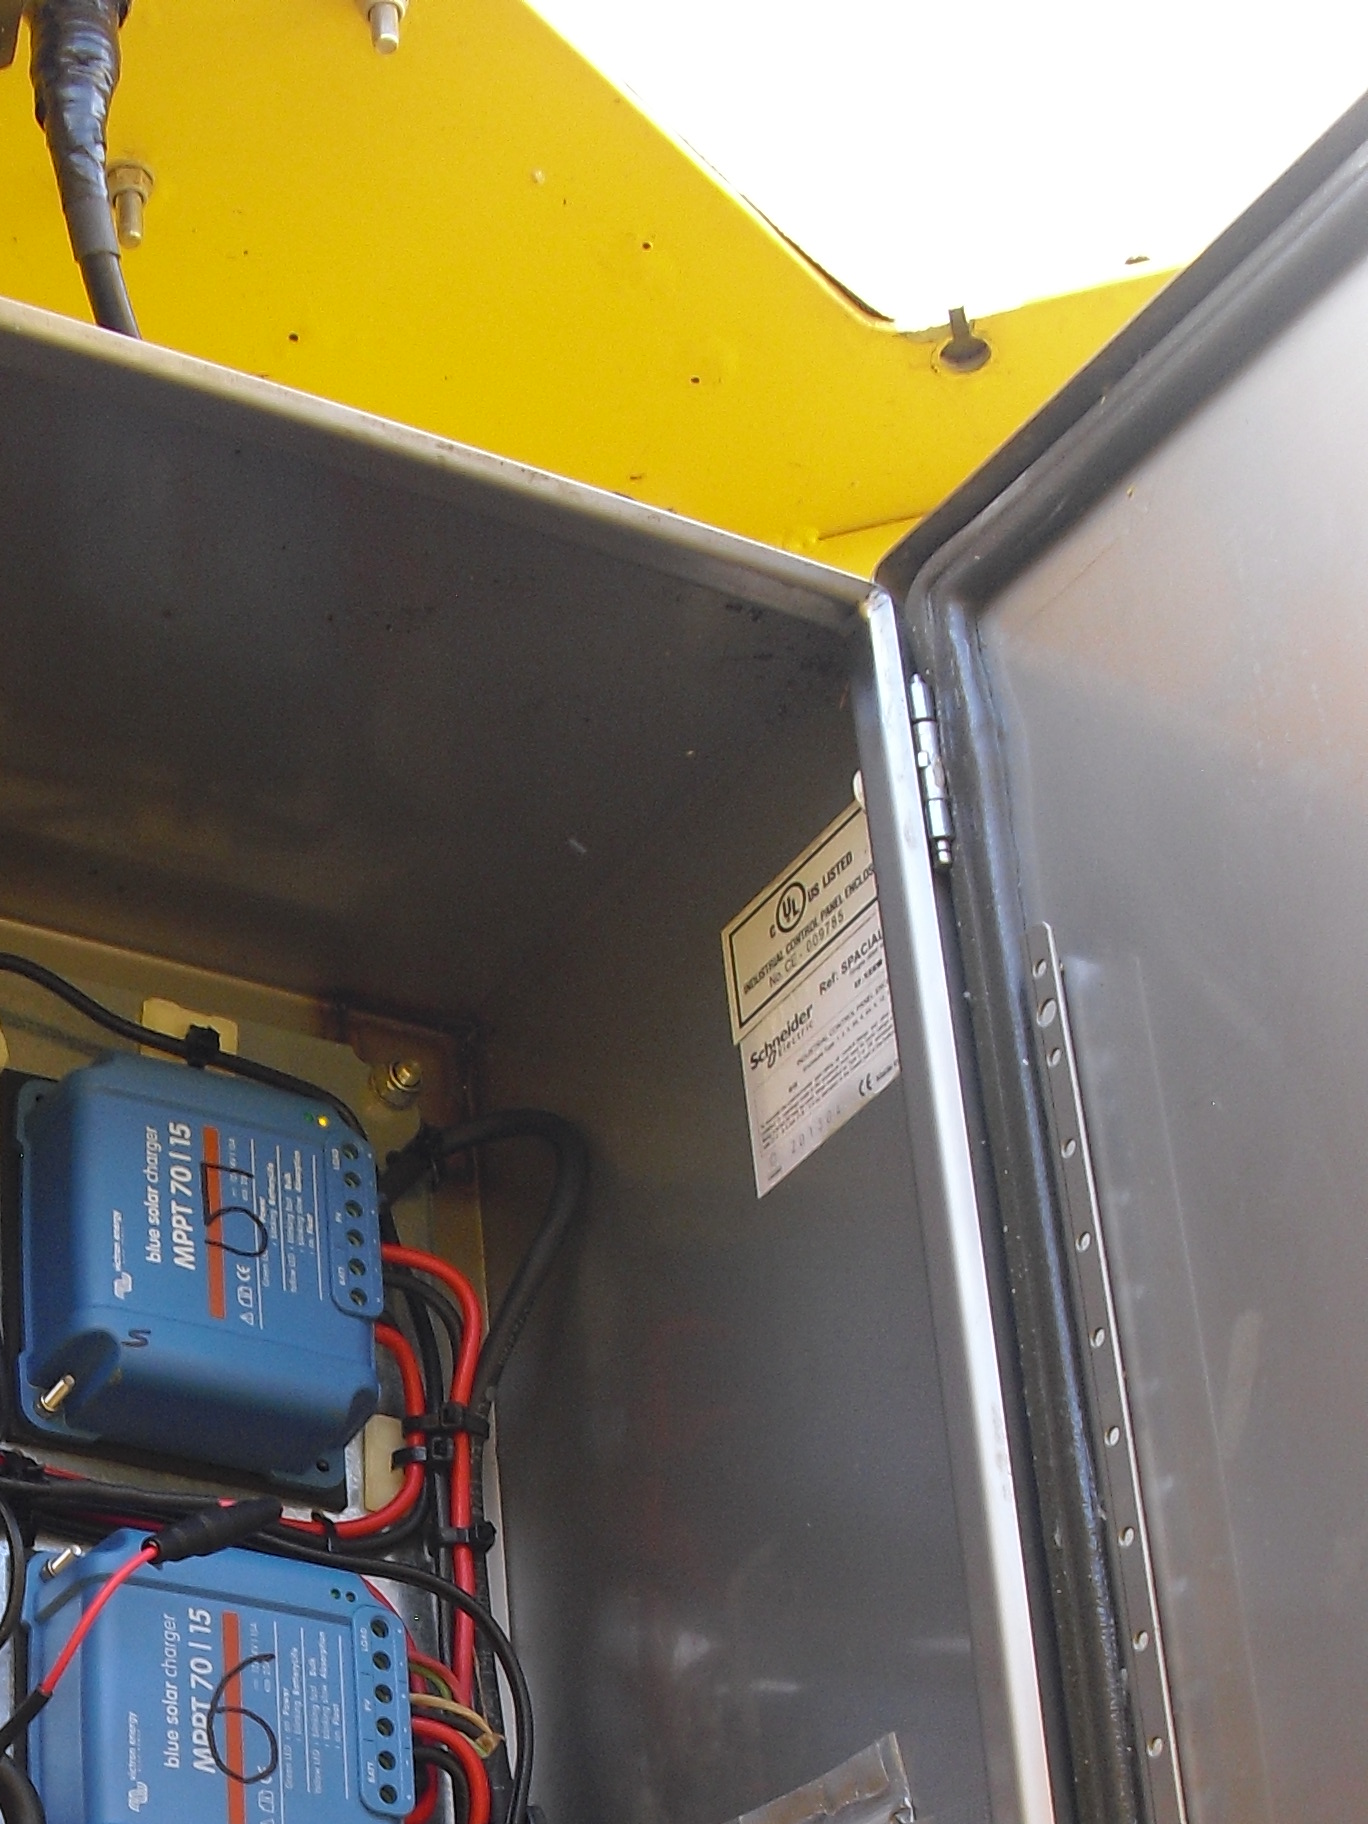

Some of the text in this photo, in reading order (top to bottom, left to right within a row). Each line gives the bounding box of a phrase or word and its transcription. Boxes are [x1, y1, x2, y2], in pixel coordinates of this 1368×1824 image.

[822, 851, 852, 889] LISTED
[743, 950, 784, 996] INDUSTRIAL
[785, 916, 819, 955] CONTROL
[820, 894, 843, 922] PANEL
[749, 1003, 813, 1072] Schneider
[168, 1121, 191, 1146] 15
[142, 1125, 163, 1263] blue solar charger
[169, 1165, 193, 1196] 70
[171, 1199, 196, 1270] MPPT
[236, 1263, 251, 1281] CE
[188, 1607, 211, 1634] 15
[160, 1612, 181, 1768] blue solar charger
[189, 1657, 214, 1691] 70
[190, 1695, 216, 1773] MPPT
[206, 1652, 278, 1784] 6
